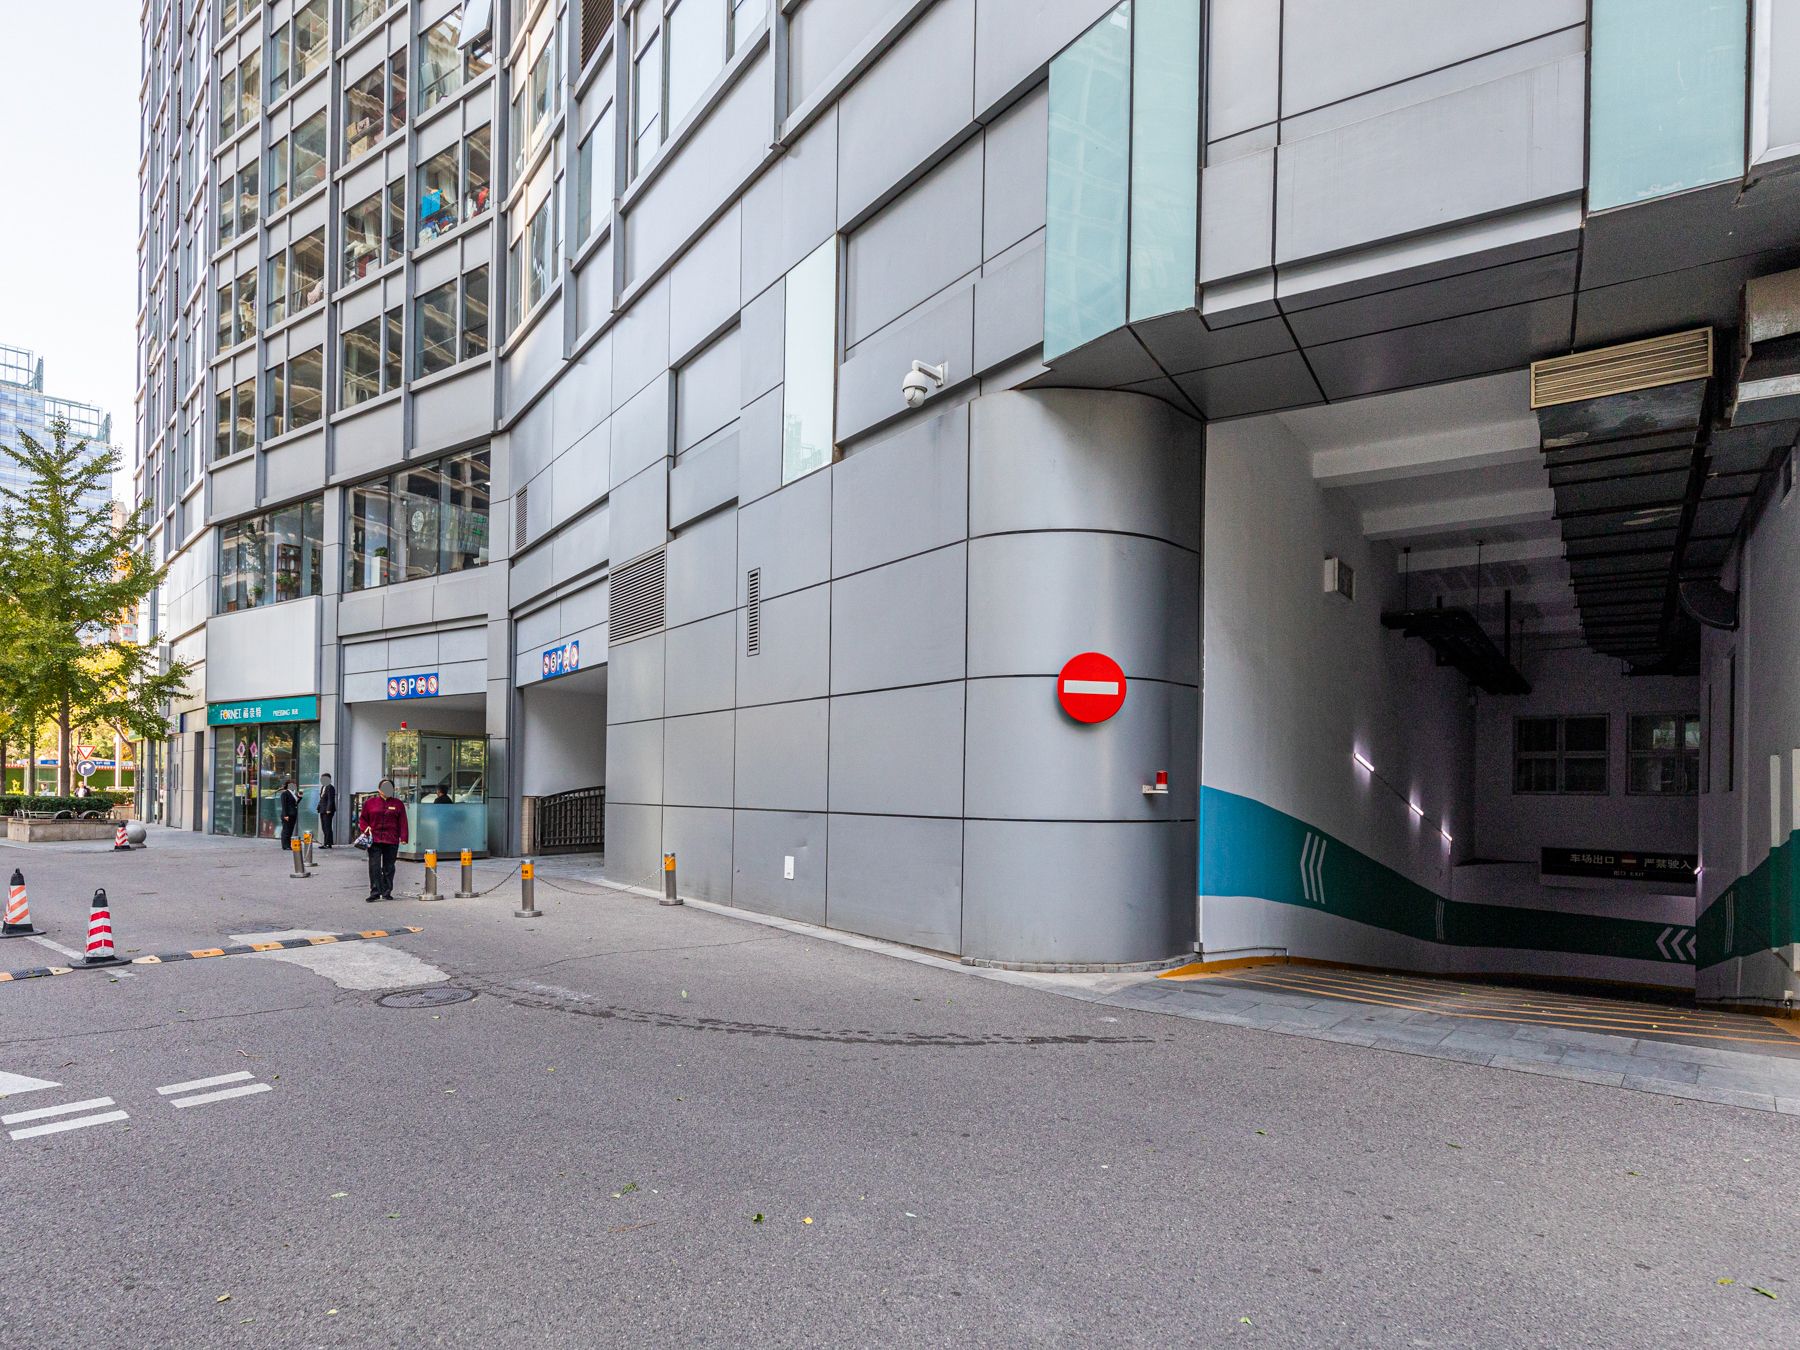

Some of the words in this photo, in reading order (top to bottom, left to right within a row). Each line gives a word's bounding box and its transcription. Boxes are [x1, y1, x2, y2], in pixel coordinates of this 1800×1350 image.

[557, 650, 563, 671] P
[401, 682, 406, 692] 5
[408, 678, 416, 695] P
[220, 709, 242, 720] FORNET
[1569, 853, 1615, 865] 车场出口
[1643, 858, 1692, 870] 严禁驶入
